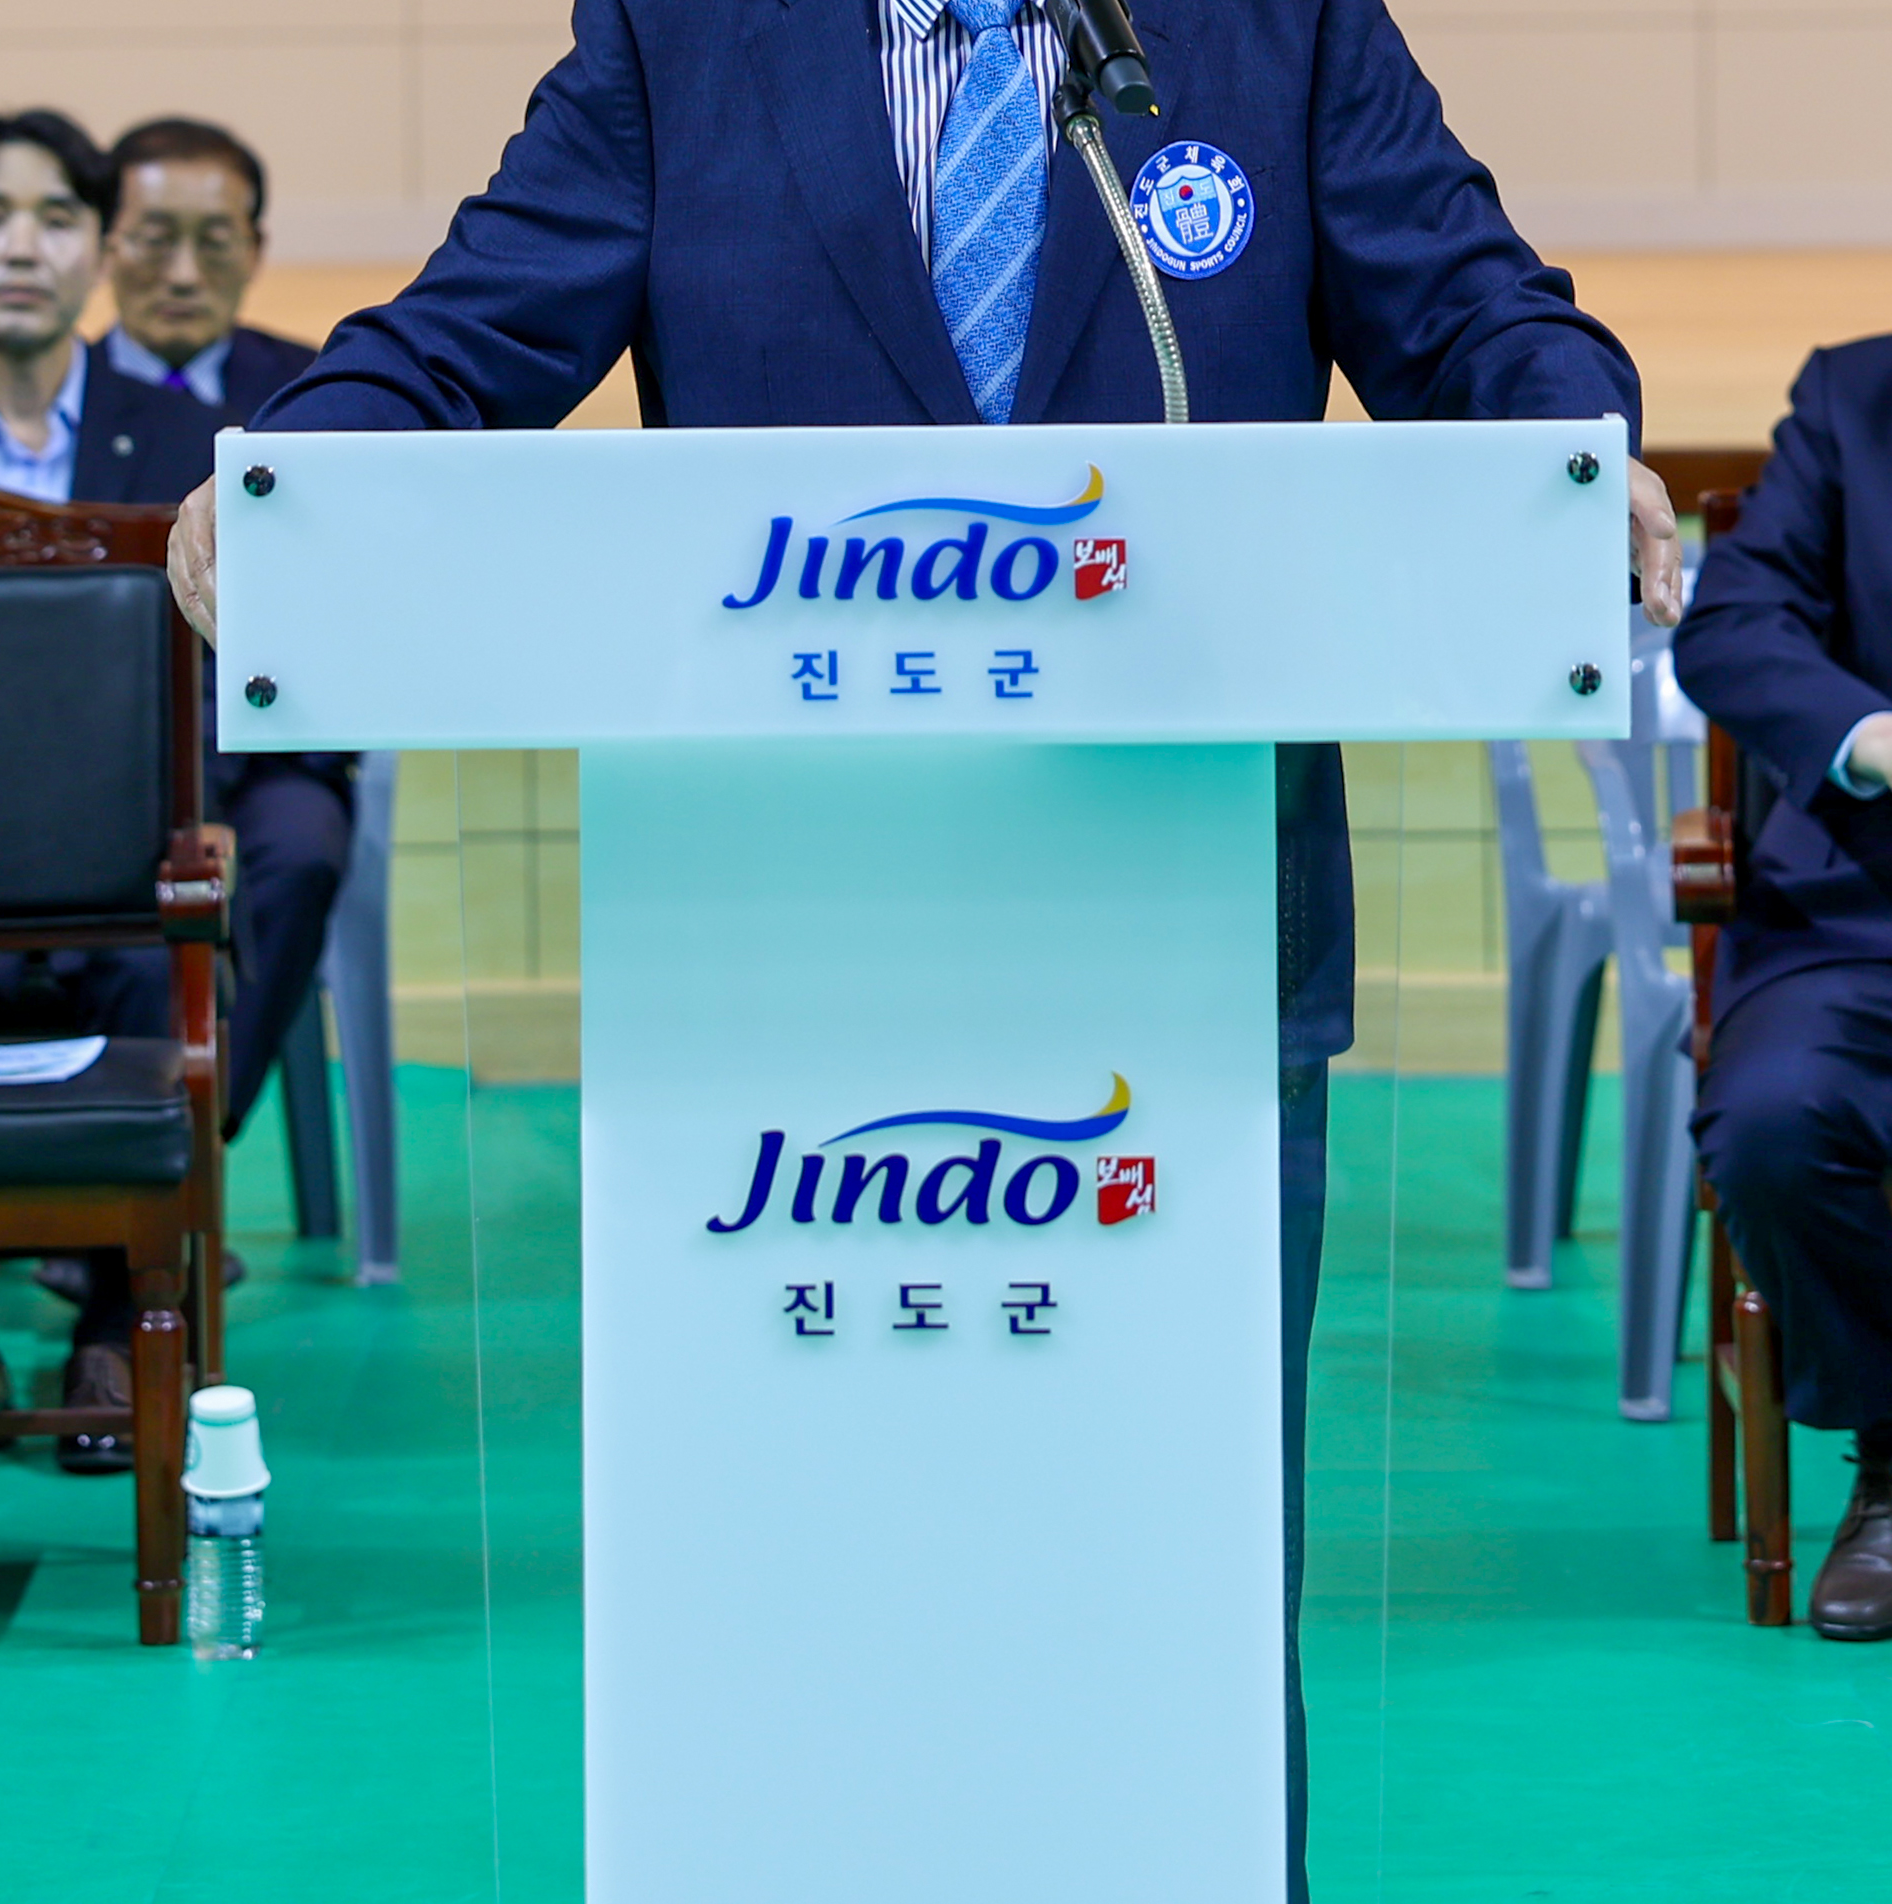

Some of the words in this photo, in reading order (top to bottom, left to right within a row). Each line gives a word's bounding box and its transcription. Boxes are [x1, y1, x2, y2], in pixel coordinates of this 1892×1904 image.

[1134, 145, 1245, 219] 진도군체육회
[1146, 237, 1186, 271] JINDOGUN
[1190, 250, 1224, 271] SPORTS
[1224, 212, 1247, 252] COUNCIL
[1175, 202, 1214, 245] 體
[722, 516, 1059, 609] Jindo
[706, 1129, 1080, 1233] Jindo
